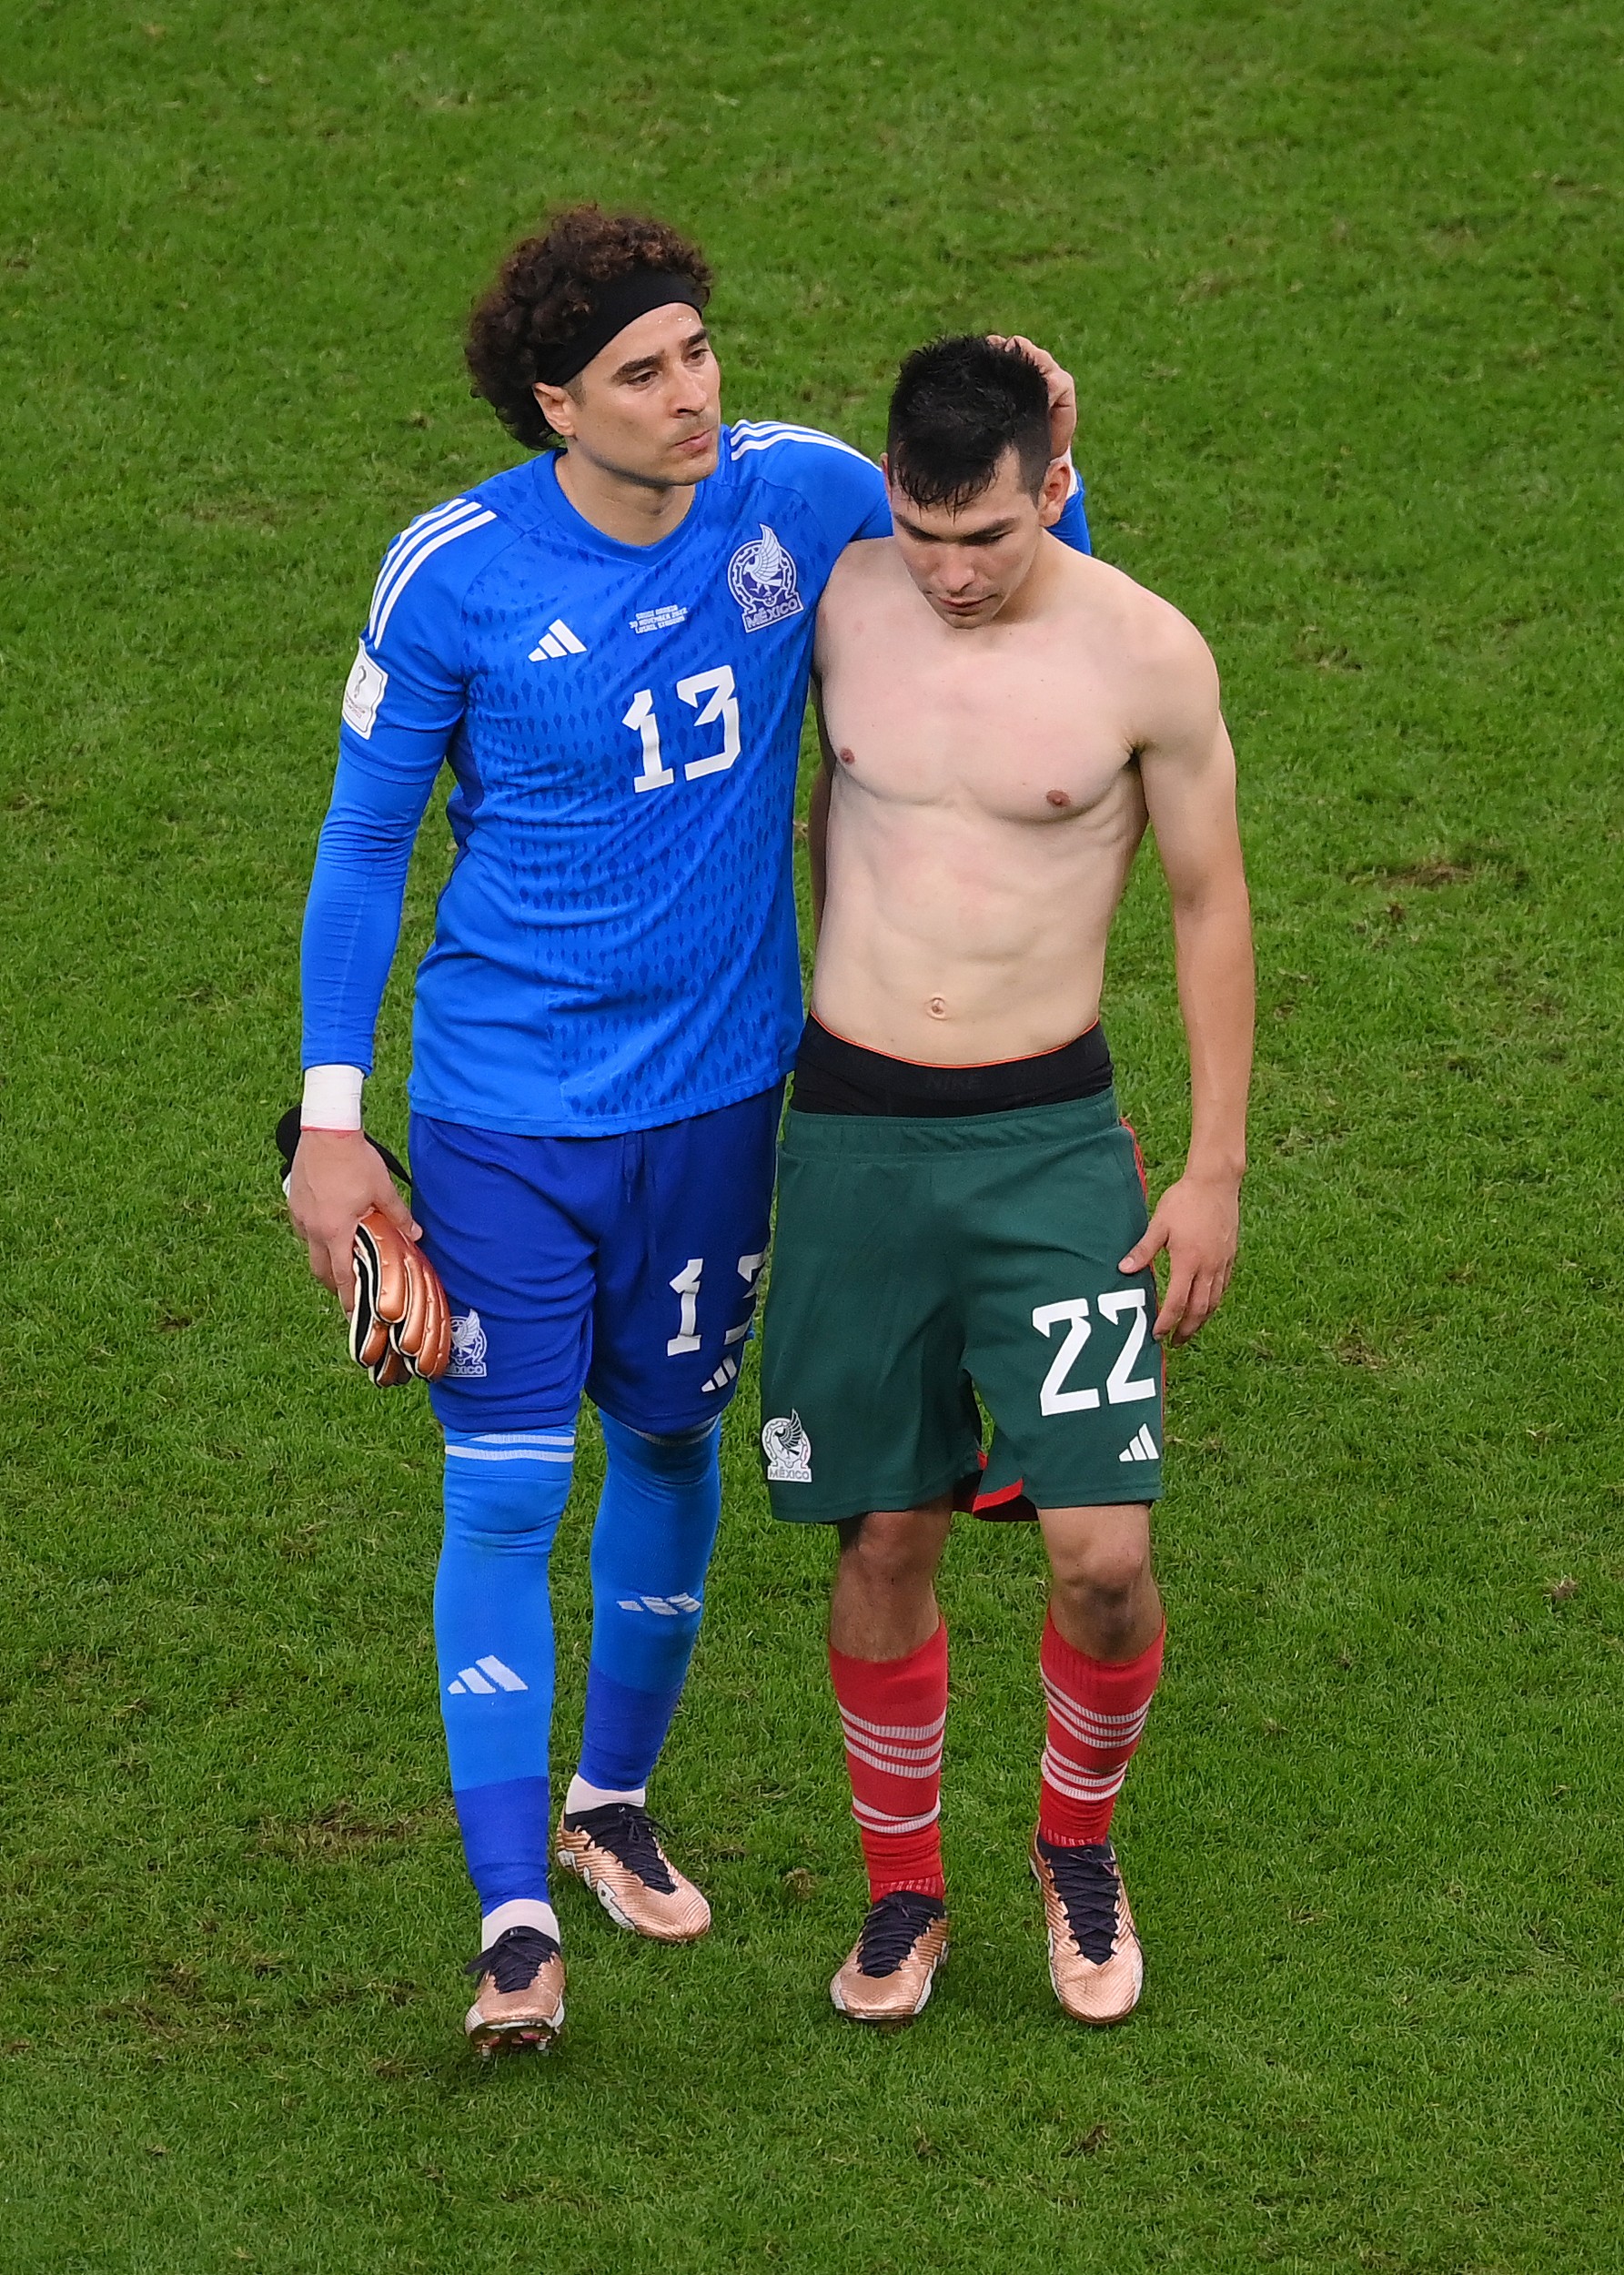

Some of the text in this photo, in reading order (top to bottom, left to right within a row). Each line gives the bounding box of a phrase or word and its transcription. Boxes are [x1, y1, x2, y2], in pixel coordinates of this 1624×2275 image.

[621, 664, 741, 794] 13
[1032, 1288, 1156, 1416] 22
[769, 1466, 810, 1481] MÉXICO
